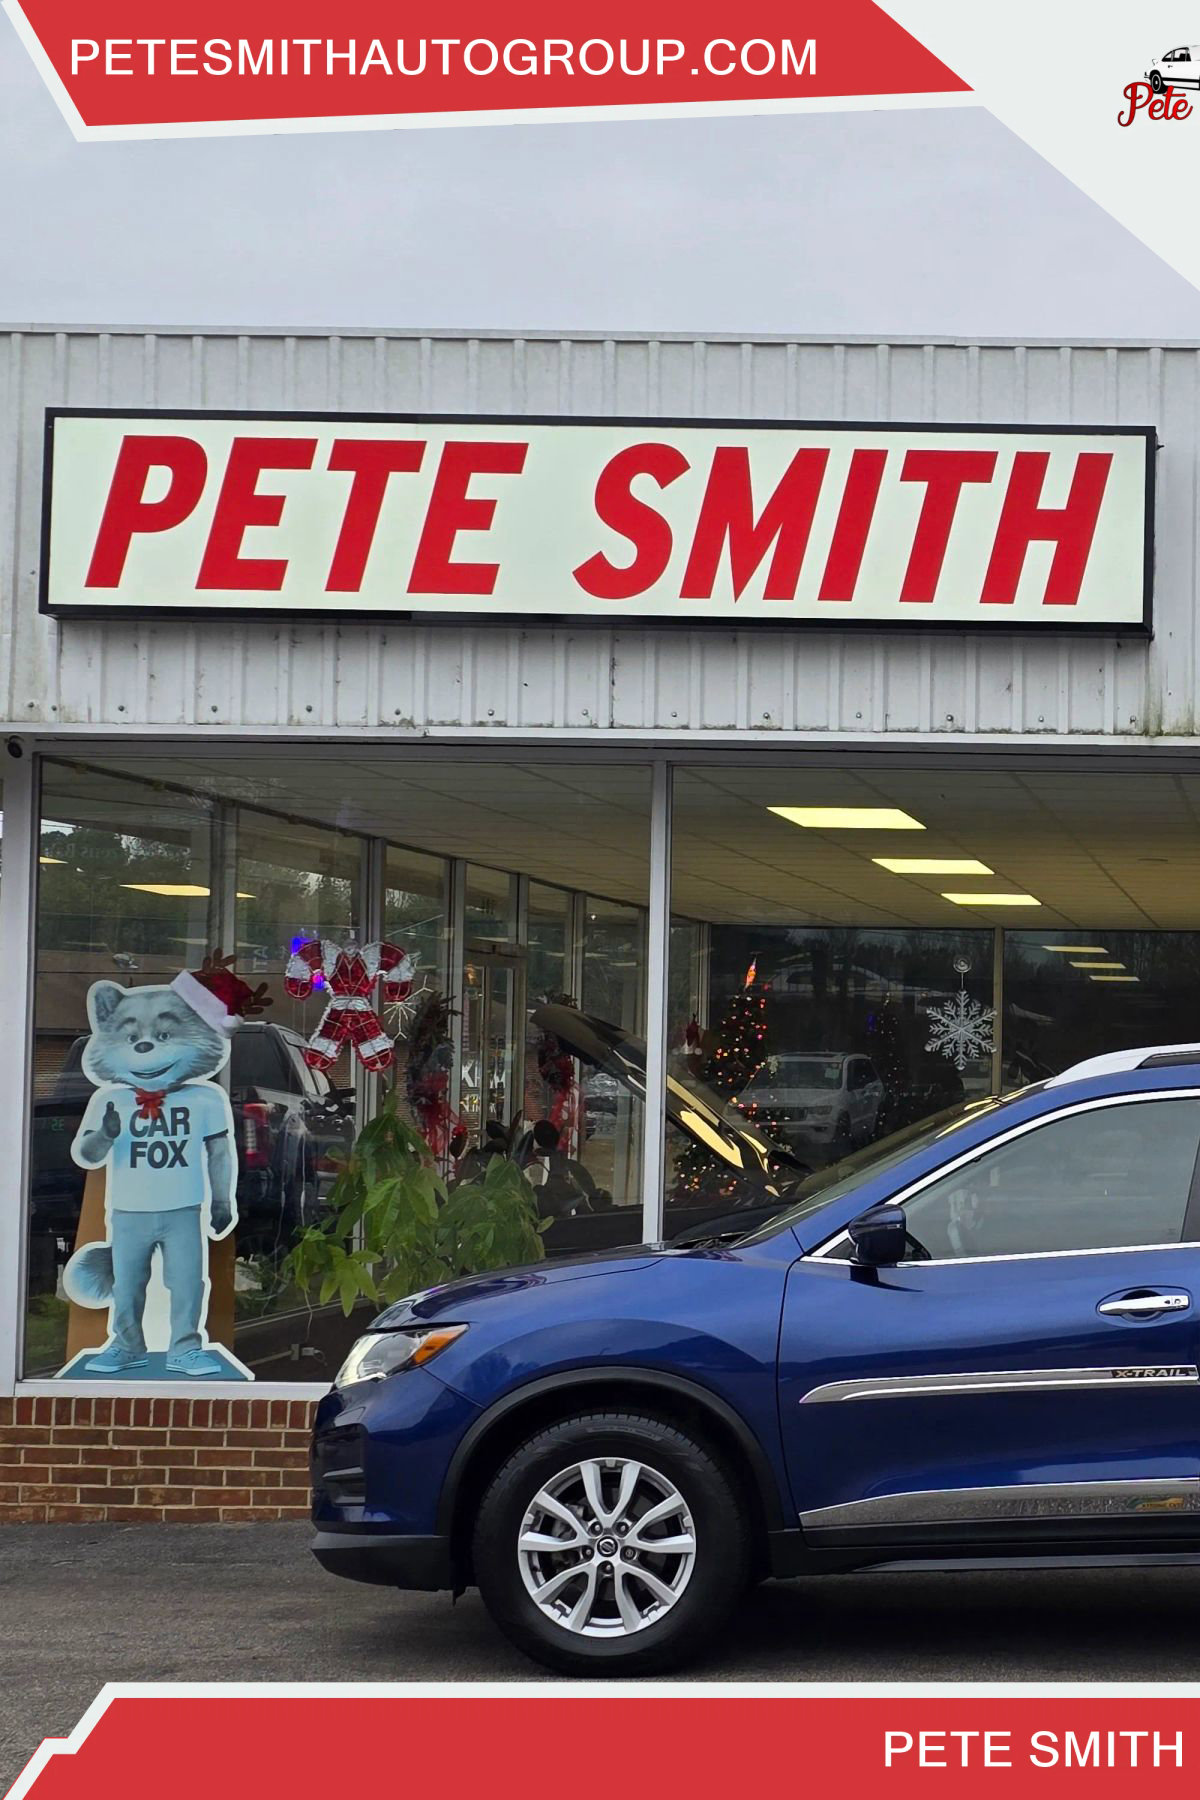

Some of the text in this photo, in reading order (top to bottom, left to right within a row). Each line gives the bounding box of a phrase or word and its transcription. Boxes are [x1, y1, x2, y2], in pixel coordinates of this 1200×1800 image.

[86, 435, 1114, 606] PETE SMITH
[129, 1107, 190, 1138] CAR
[130, 1140, 189, 1168] FOX
[1116, 1368, 1187, 1378] X-TRAIL
